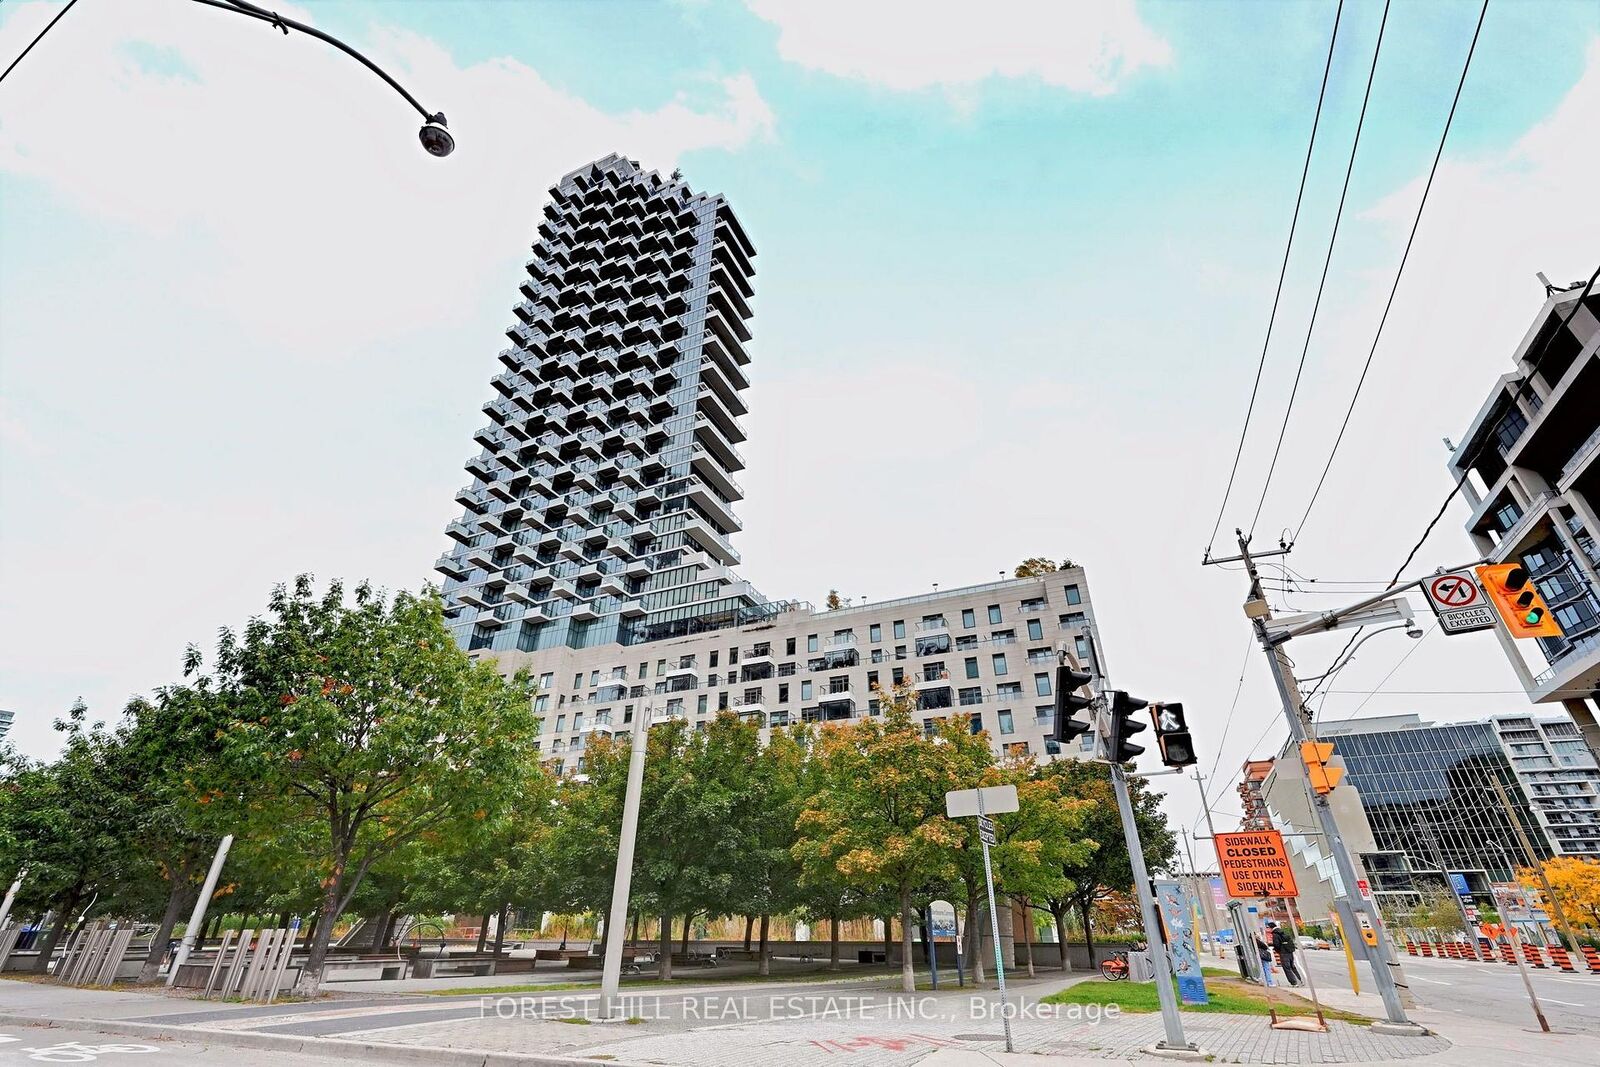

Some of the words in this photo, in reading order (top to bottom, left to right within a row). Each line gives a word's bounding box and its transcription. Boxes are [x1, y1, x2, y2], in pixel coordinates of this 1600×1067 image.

[1447, 609, 1486, 621] BICYCLES
[1450, 616, 1491, 627] EXCEPTED
[1225, 836, 1272, 846] SIDEWALK
[1227, 847, 1276, 857] CLOSED
[1224, 858, 1286, 869] PEDESTRIANS
[1232, 870, 1250, 880] USE
[1252, 869, 1284, 879] OTHER
[1237, 881, 1286, 892] SIDEWALK
